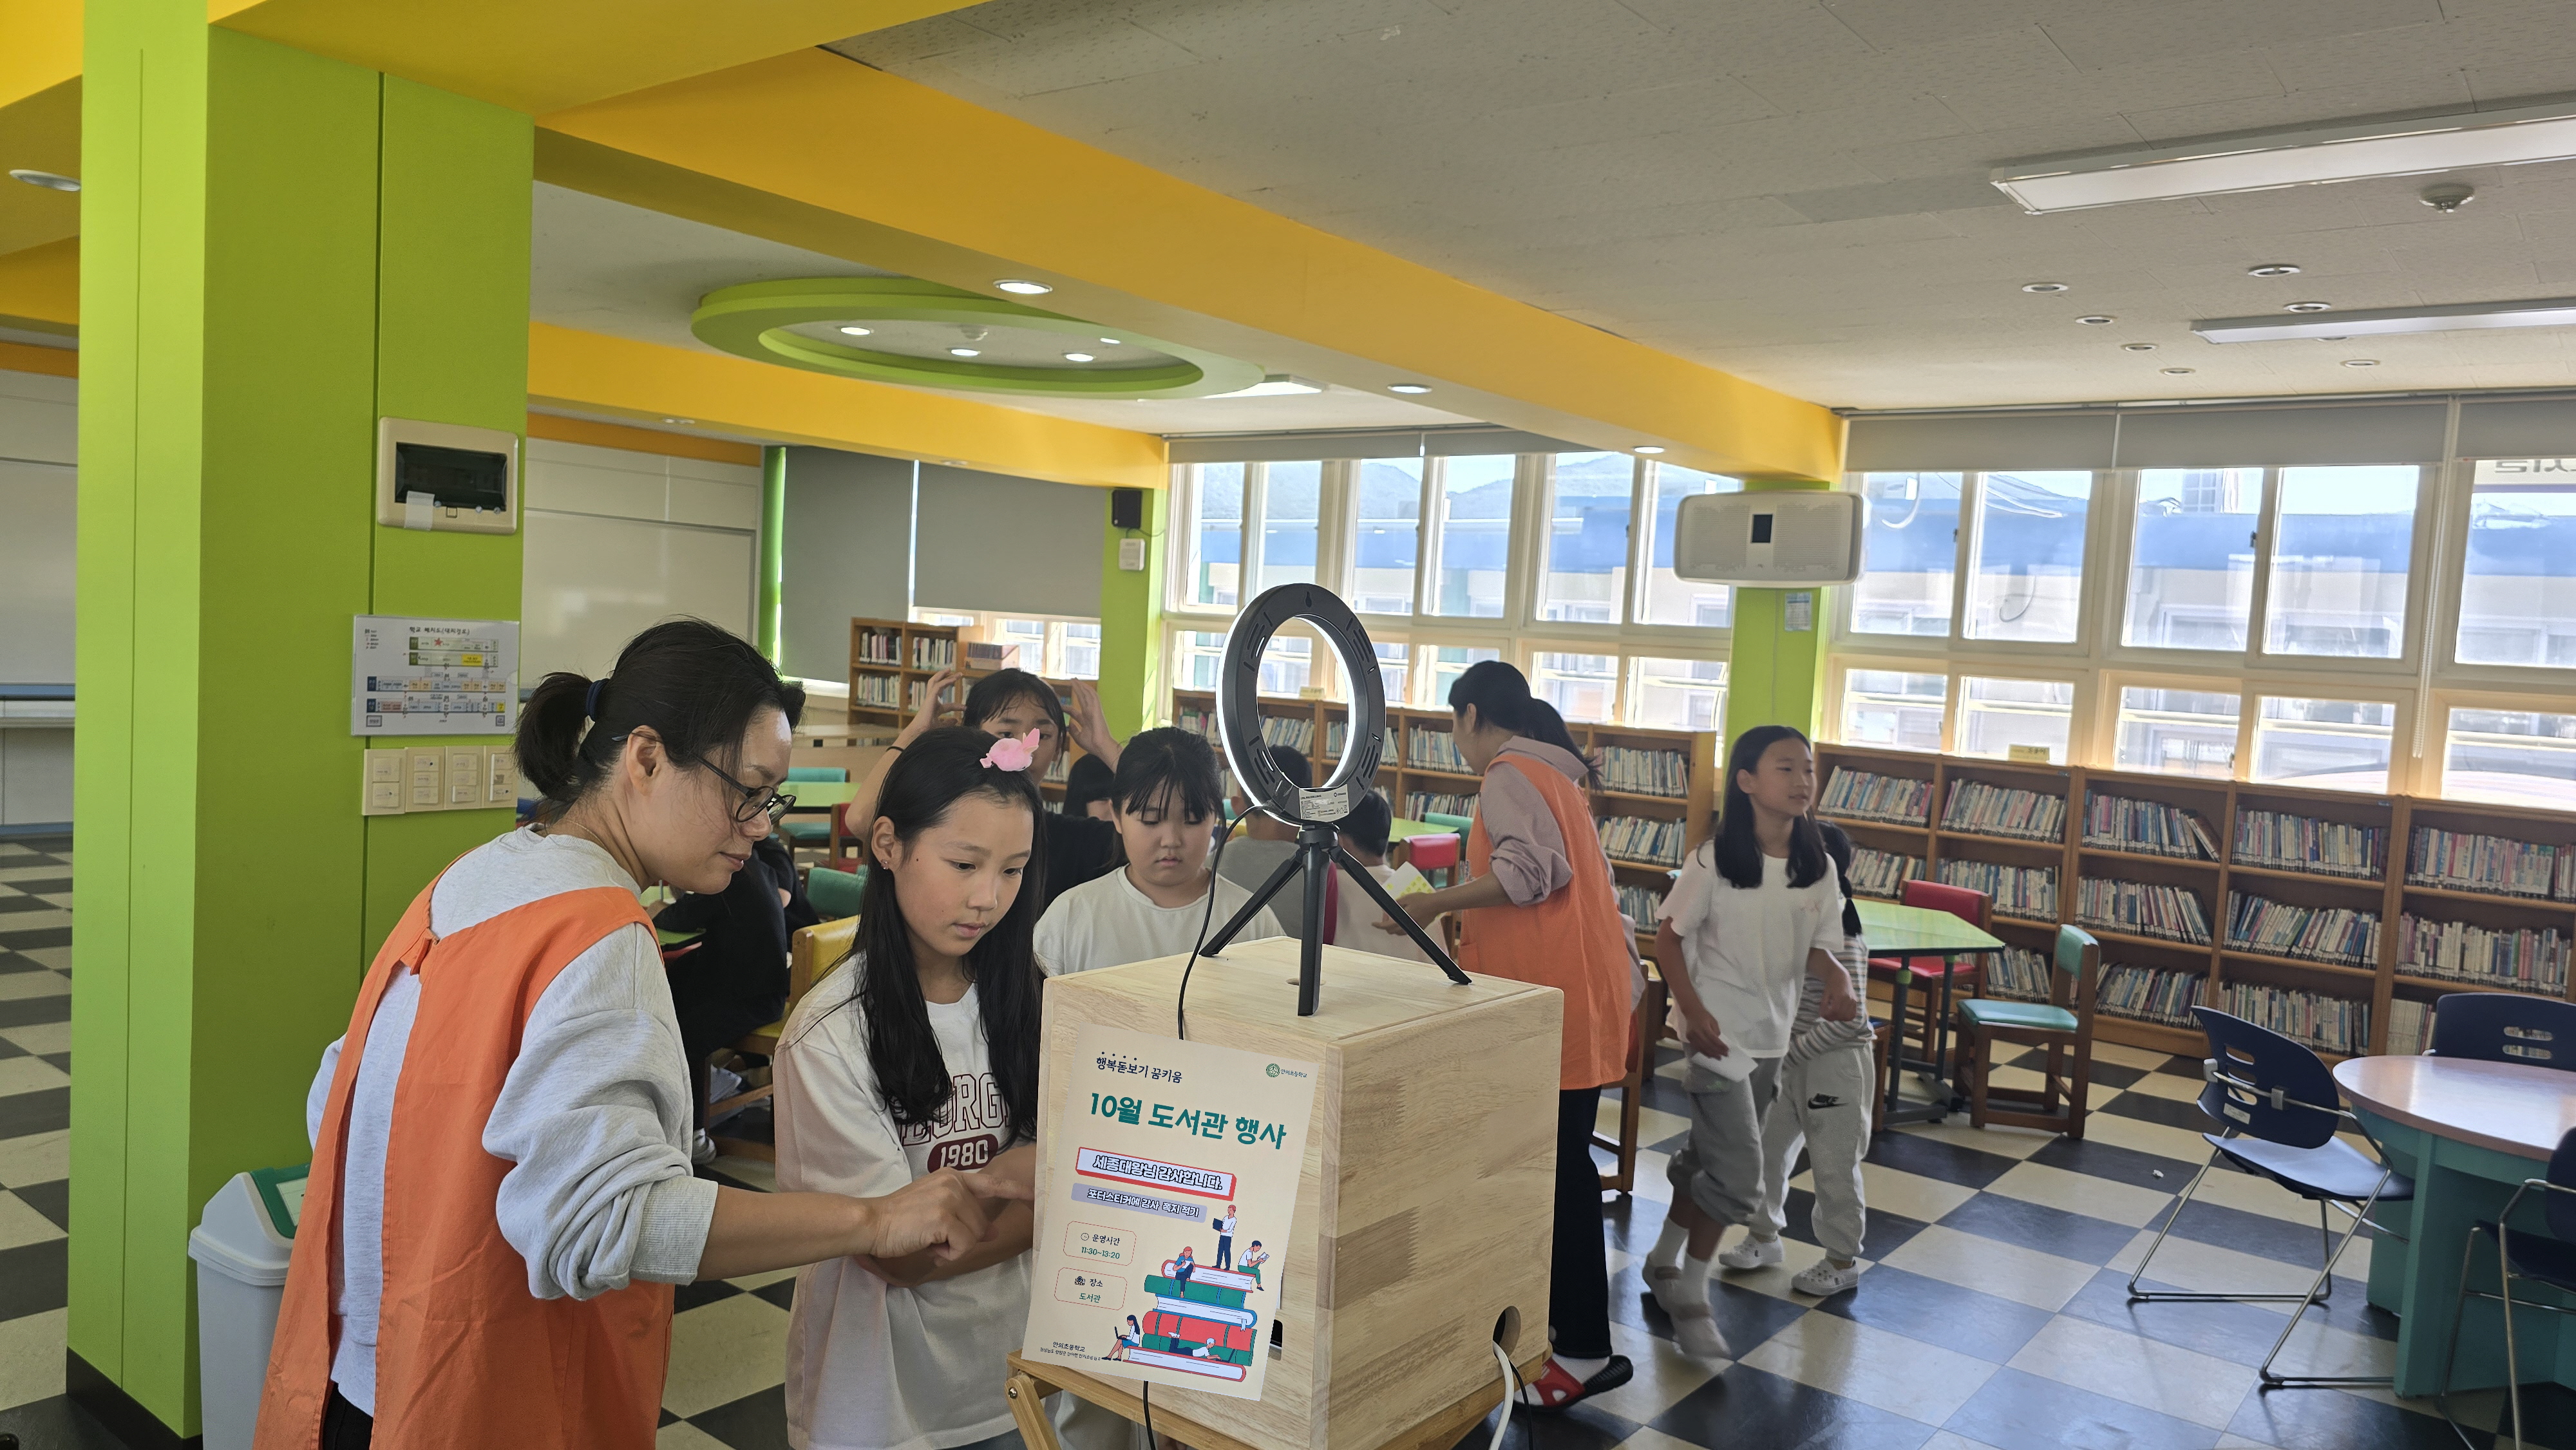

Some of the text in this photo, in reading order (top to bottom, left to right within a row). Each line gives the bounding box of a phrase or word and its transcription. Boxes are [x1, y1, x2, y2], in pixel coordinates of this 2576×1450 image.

[1096, 1057, 1182, 1084] 행복돋보기 꿈키움
[1091, 1093, 1287, 1149] 10월 도서관 행사
[940, 1139, 989, 1168] 1980
[1093, 1154, 1222, 1190] 세종대왕님 감사합니다.
[1087, 1189, 1199, 1217] 포터스티커에 감사 쪽지 적기
[1092, 1234, 1120, 1246] 운영시간
[1081, 1247, 1120, 1259] 11:30~13:20
[1090, 1279, 1103, 1287] 장소
[1079, 1293, 1101, 1303] 도서관
[1053, 1342, 1085, 1351] 안의초등학교
